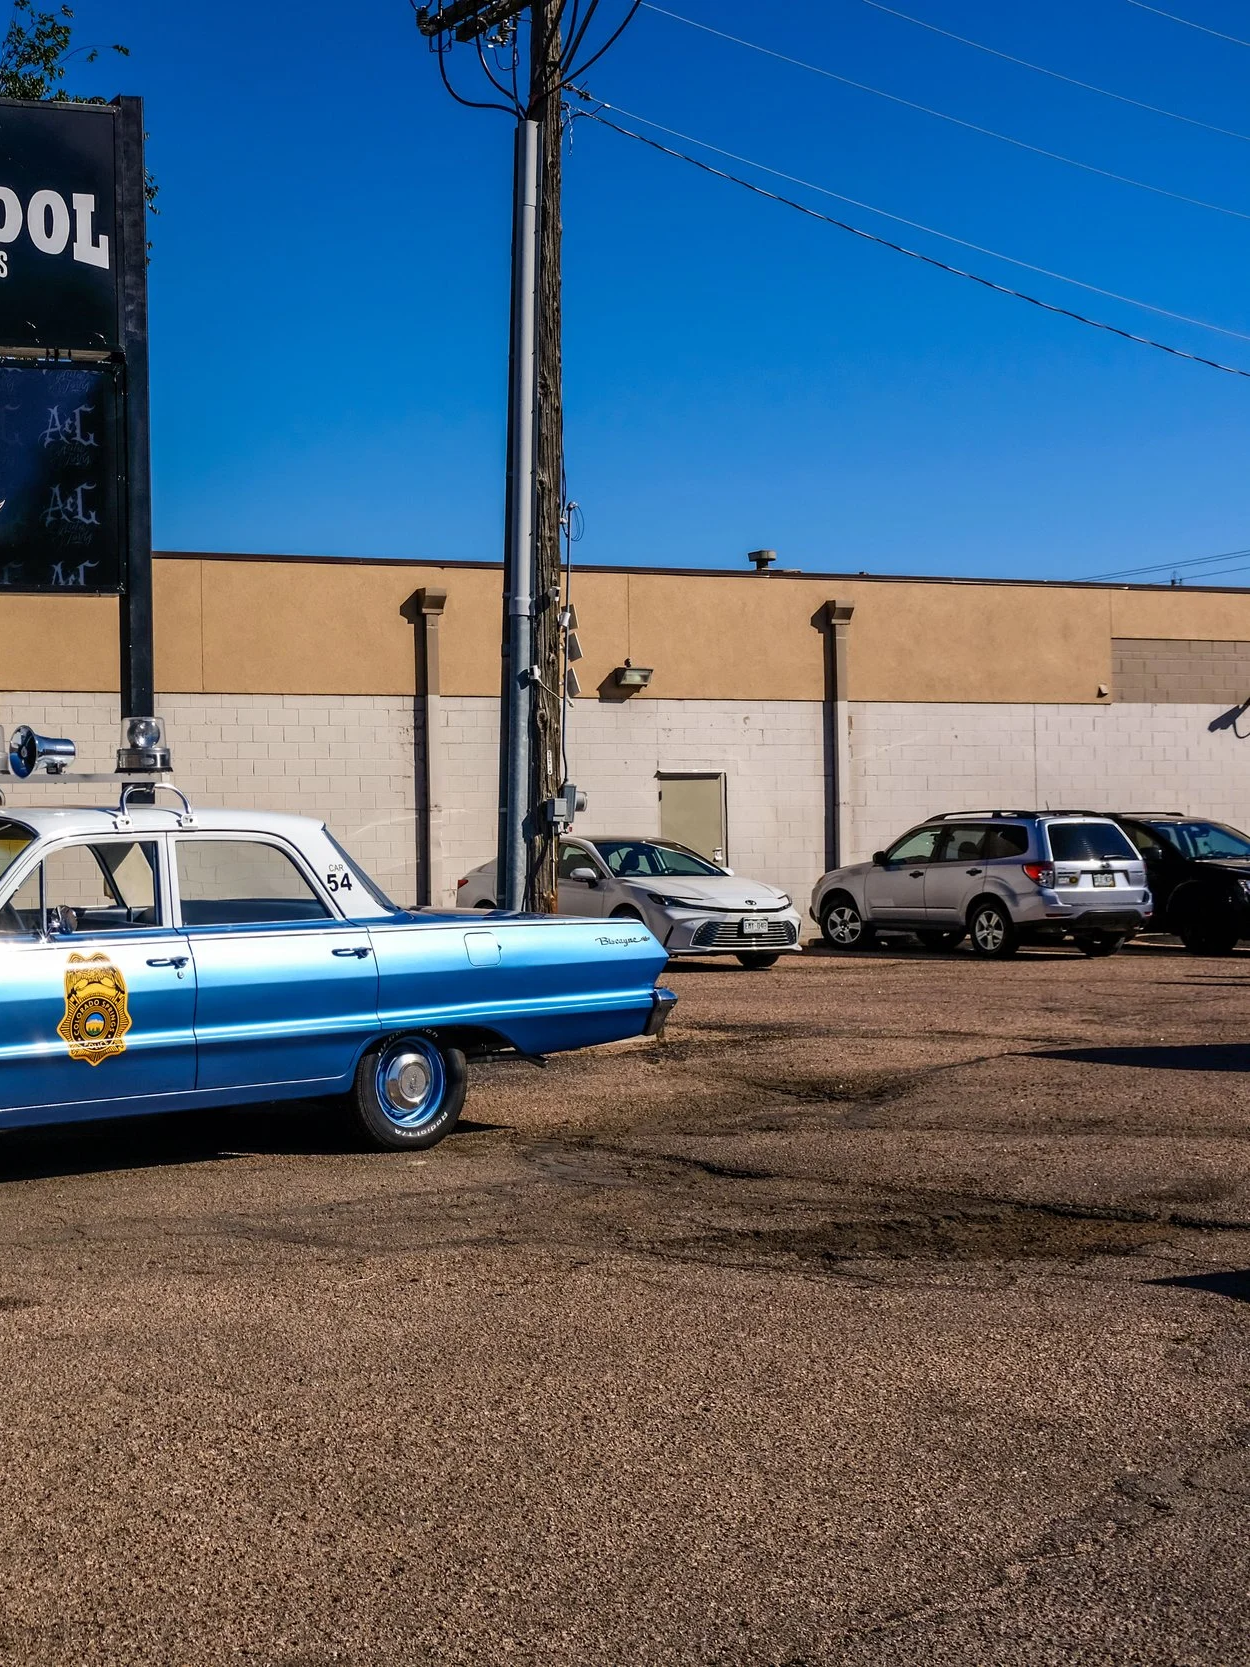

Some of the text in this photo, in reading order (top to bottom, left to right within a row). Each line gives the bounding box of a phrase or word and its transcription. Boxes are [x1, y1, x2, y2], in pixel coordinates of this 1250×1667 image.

[327, 873, 352, 892] 54
[73, 999, 116, 1035] COLORADO SPRINGS
